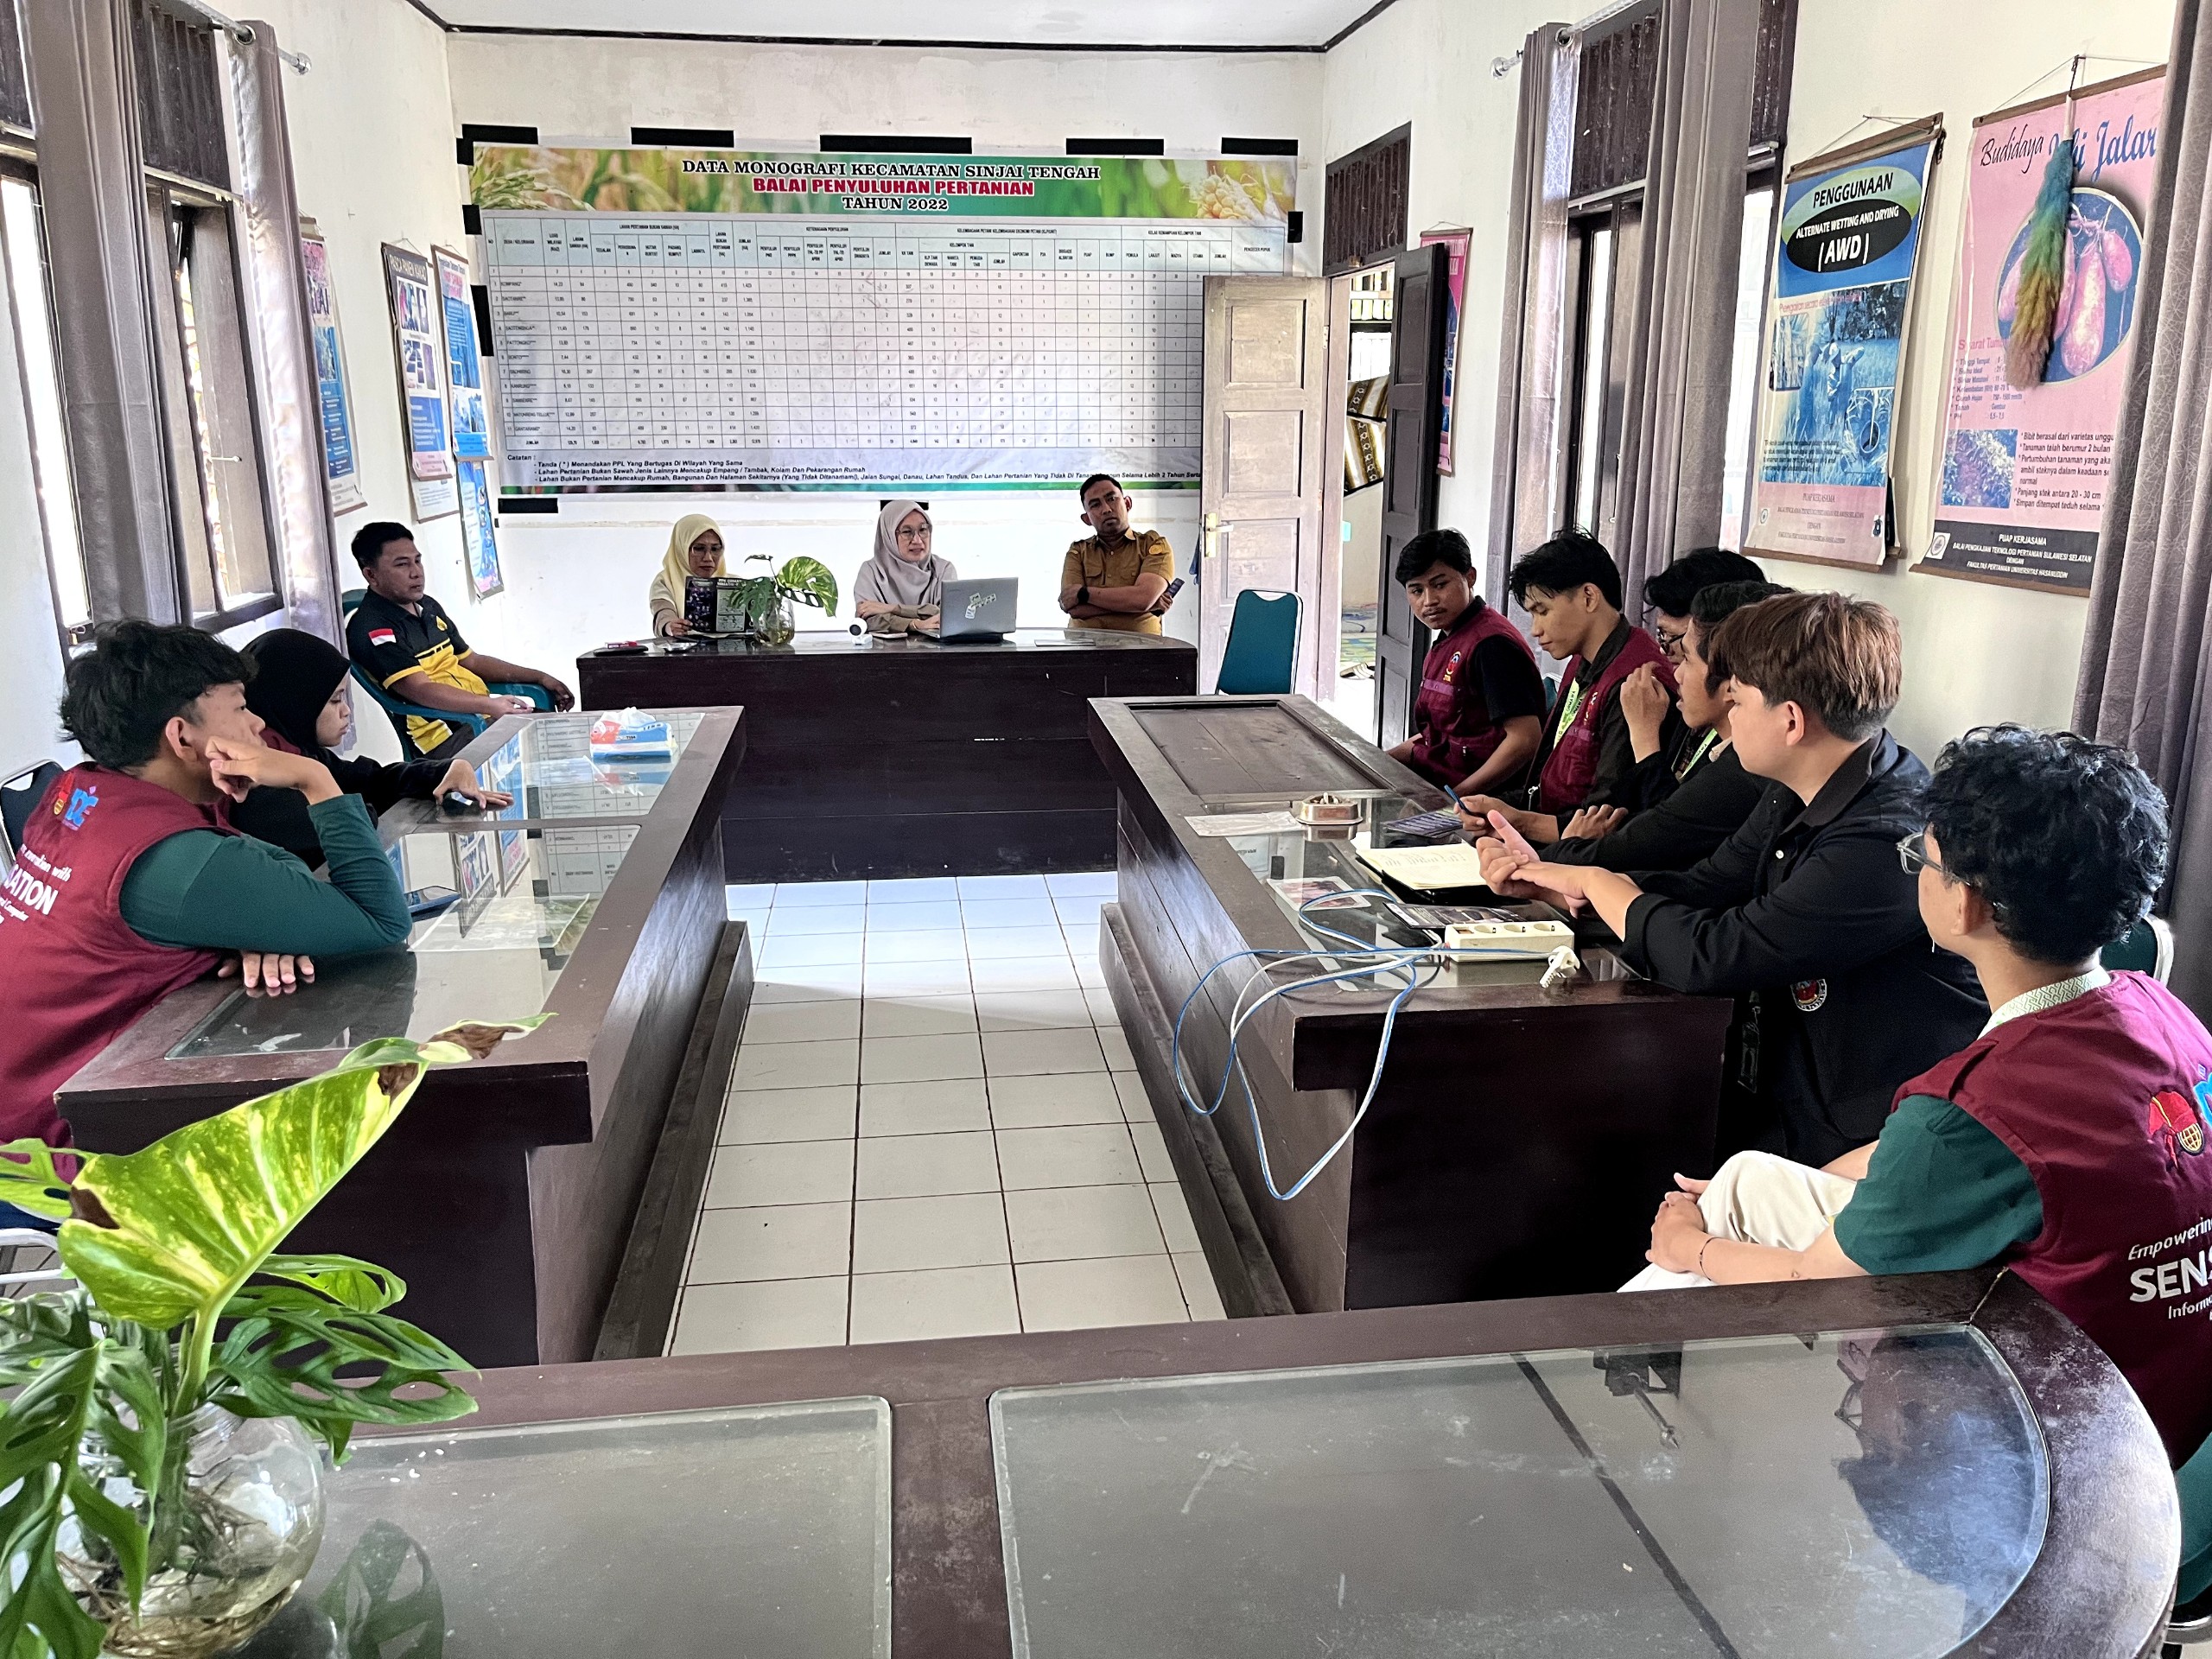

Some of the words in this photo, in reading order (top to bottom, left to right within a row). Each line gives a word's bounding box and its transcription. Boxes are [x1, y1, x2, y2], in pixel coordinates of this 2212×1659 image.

[1980, 124, 2044, 175] Budidaya
[2091, 114, 2158, 185] Jalar
[682, 160, 729, 174] DATA
[734, 161, 846, 176] MONOGRAFI
[851, 163, 960, 177] KECAMATAN
[964, 166, 1023, 179] SINJAI
[1028, 166, 1101, 180] TENGAH
[753, 178, 807, 193] BALAI
[812, 179, 930, 194] PENYULUHAN
[935, 181, 1034, 196] PERTANIAN
[1813, 172, 1893, 208] PENGGUNAAN
[842, 196, 903, 210] TAHUN
[908, 199, 948, 210] 2022
[1796, 221, 1830, 239] ALTERNATE
[1831, 214, 1859, 232] WETTING
[1859, 211, 1874, 226] AND
[1874, 206, 1899, 222] DRYING
[1958, 338, 1986, 350] Sarat
[2023, 431, 2036, 441] Bibit
[2036, 432, 2057, 441] berasal
[2046, 443, 2061, 452] telah
[2062, 443, 2088, 453] berumur
[2088, 443, 2092, 453] 2
[2093, 444, 2111, 453] bulan
[2021, 454, 2056, 463] Pertumbuhan
[2057, 455, 2083, 464] tanaman
[2083, 457, 2099, 466] yang
[2020, 466, 2035, 474] ambil
[2058, 467, 2076, 475] dalam
[2077, 467, 2102, 476] keadaan
[2017, 487, 2038, 498] Panjang
[2039, 488, 2051, 497] stek
[2051, 489, 2070, 499] antara
[2070, 490, 2079, 499] 20
[2082, 490, 2091, 499] 30
[2015, 498, 2035, 508] Simpan
[2036, 499, 2060, 510] ditempat
[2061, 501, 2078, 511] teduh
[2079, 503, 2101, 512] selama
[1999, 533, 2012, 543] PUAP
[2012, 535, 2047, 546] KERJASAMA
[1953, 542, 1965, 550] BALAI
[1992, 546, 2017, 556] TEKNOLOGI
[2017, 548, 2043, 559] PERTANIAN
[2044, 551, 2069, 561] SULAWESI
[2069, 553, 2093, 563] SELATAN
[1987, 563, 2011, 572] PERTANIAN
[2127, 1217, 2212, 1261] Empowerin
